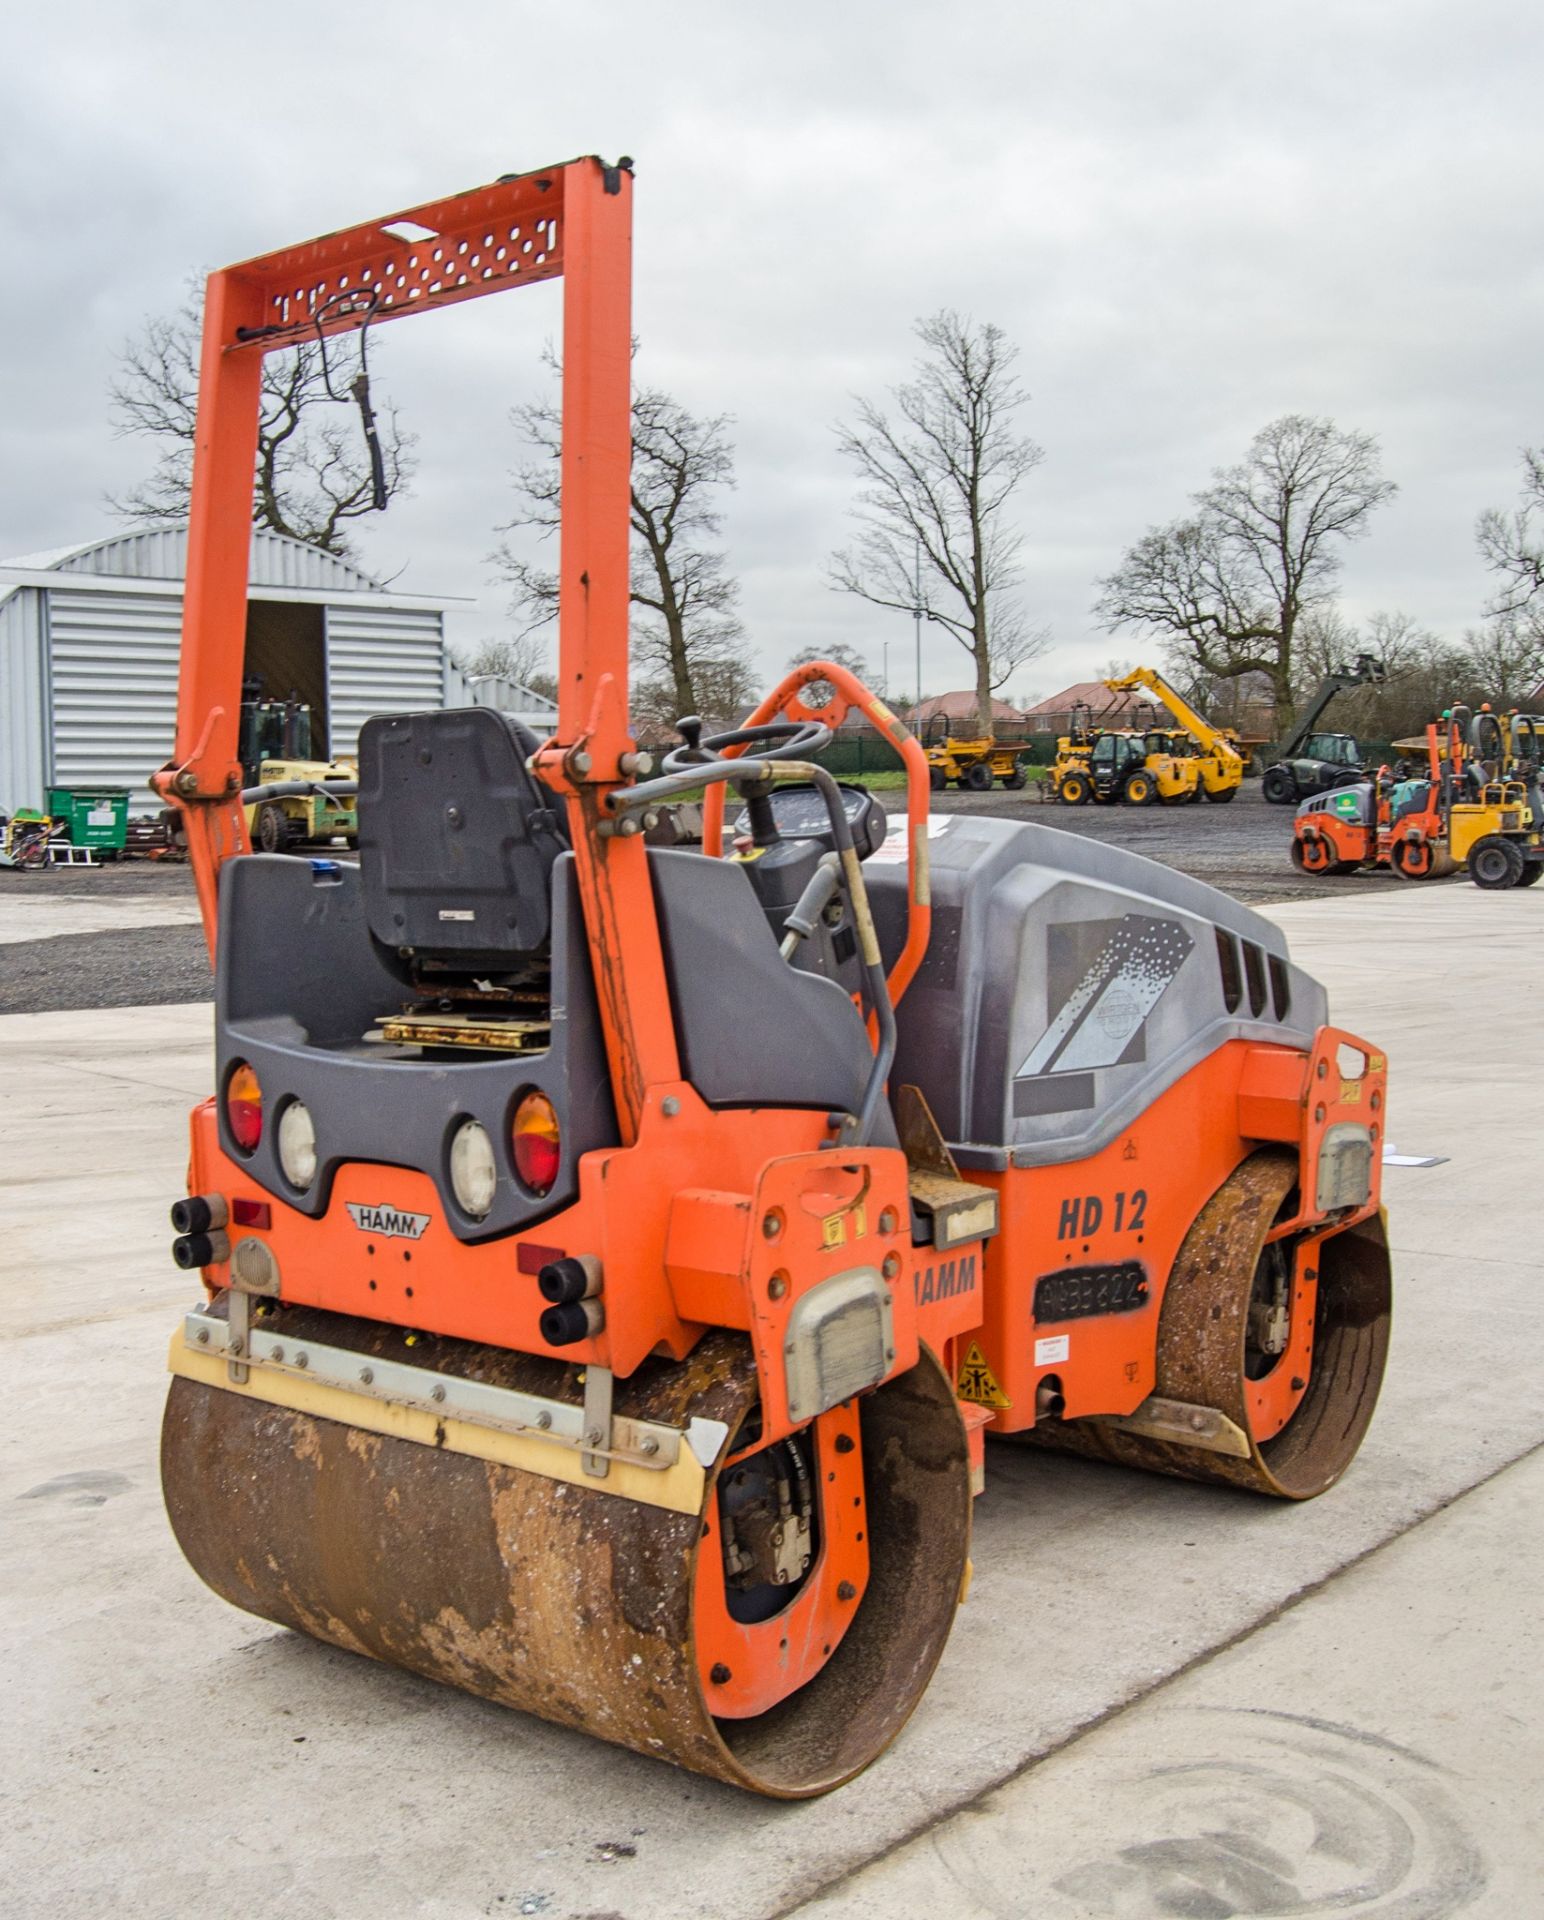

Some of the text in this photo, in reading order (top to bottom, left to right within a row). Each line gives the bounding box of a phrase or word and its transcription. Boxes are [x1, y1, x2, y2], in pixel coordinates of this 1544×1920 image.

[360, 1208, 417, 1236] HAMM
[1058, 1189, 1148, 1241] HD 12
